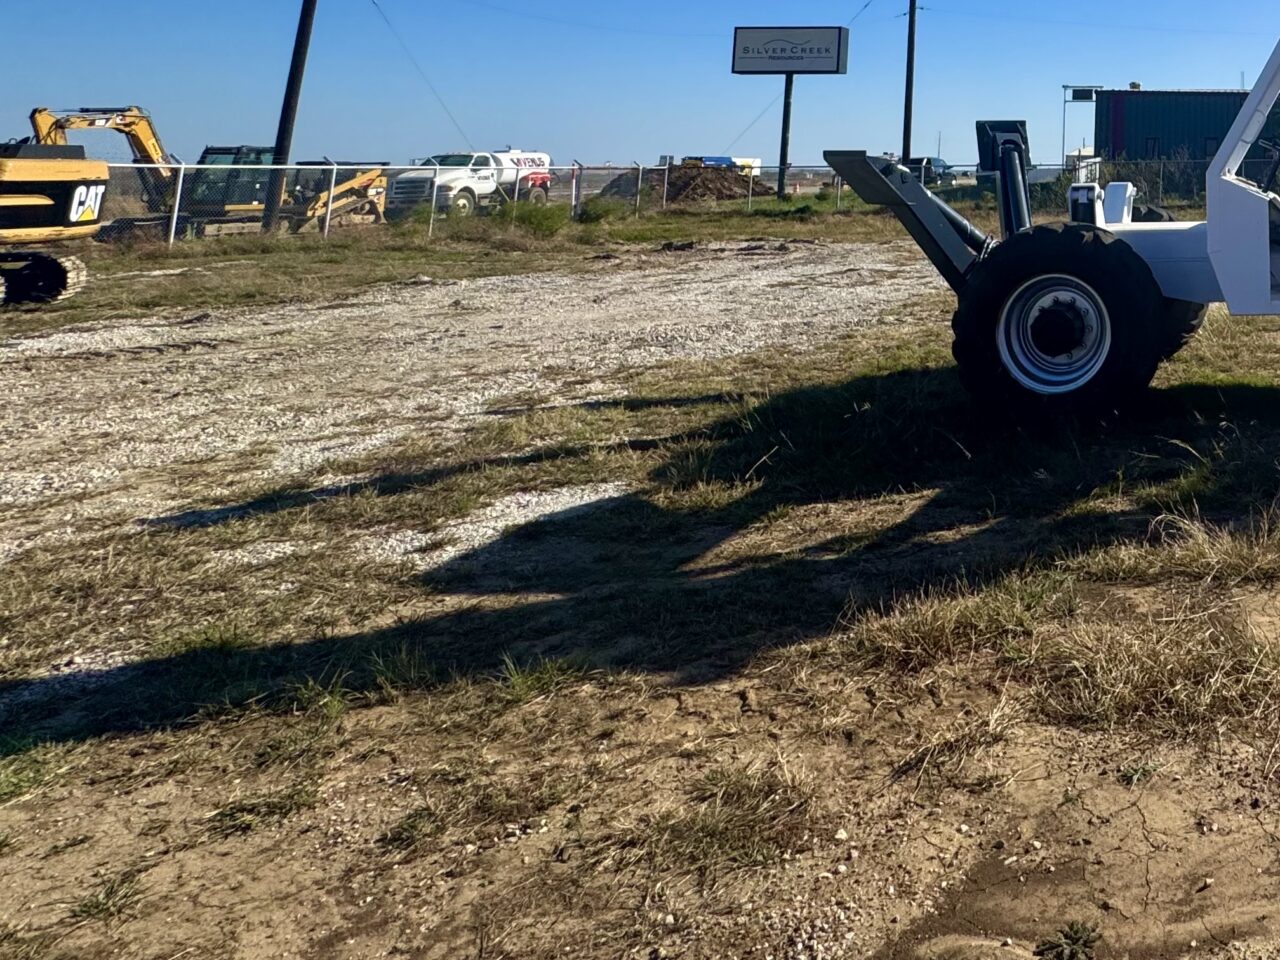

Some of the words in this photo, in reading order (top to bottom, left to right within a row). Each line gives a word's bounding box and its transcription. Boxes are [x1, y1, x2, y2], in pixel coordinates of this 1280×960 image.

[742, 46, 787, 54] SILVER
[790, 46, 832, 54] CREEK
[69, 185, 105, 222] CAT
